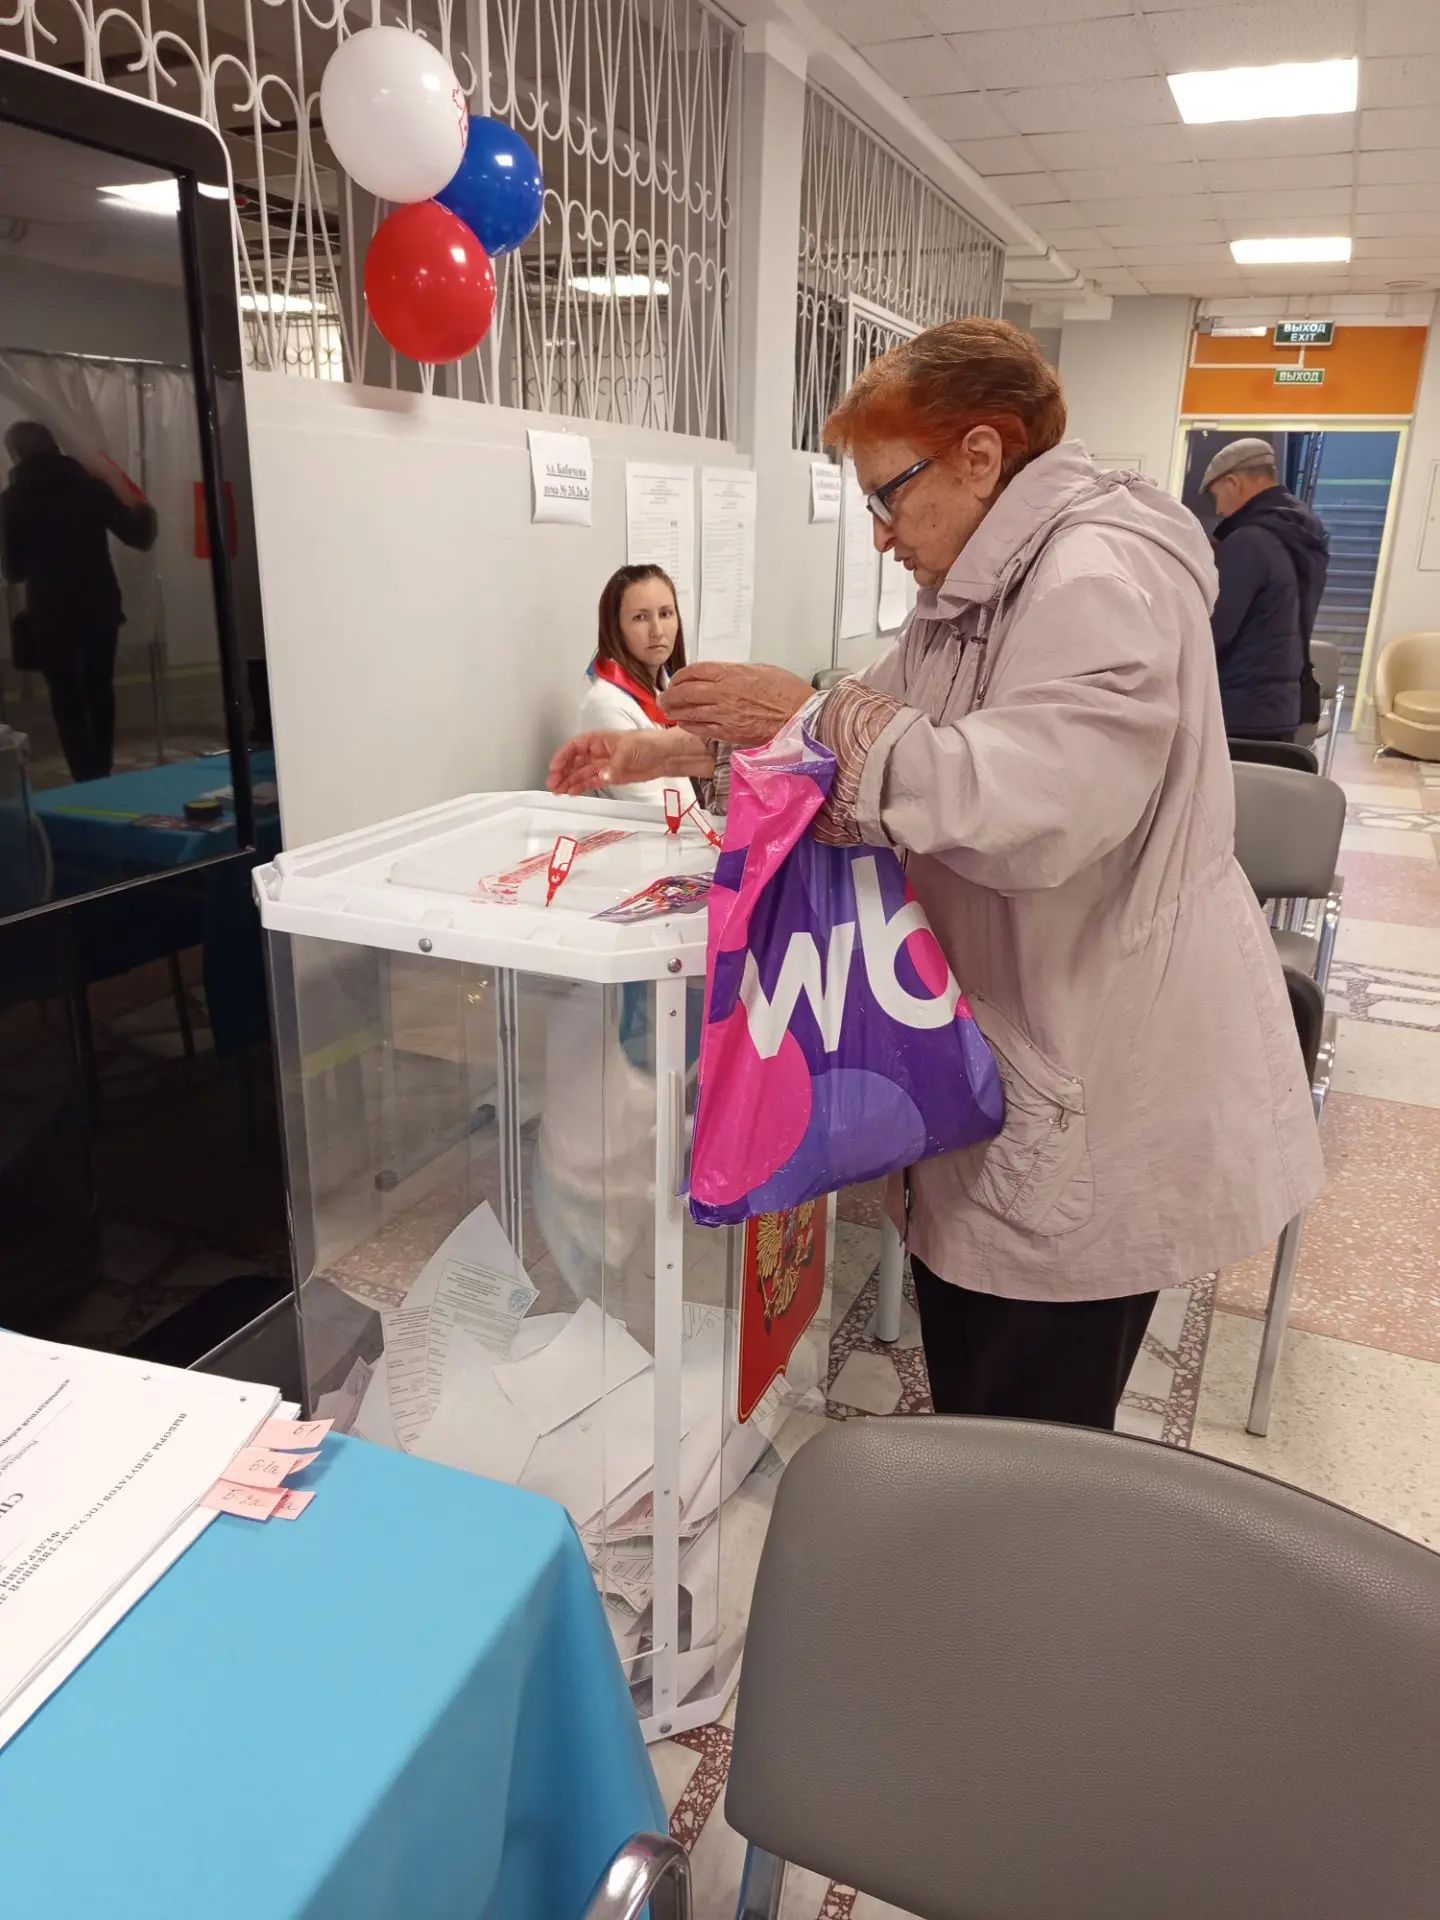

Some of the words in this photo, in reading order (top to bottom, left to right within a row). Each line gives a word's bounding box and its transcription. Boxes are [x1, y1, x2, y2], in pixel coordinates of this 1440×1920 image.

[1283, 323, 1326, 334] ВЫХОД
[1290, 333, 1316, 342] EXIT
[1278, 372, 1320, 382] ВЫХОД
[152, 1412, 188, 1451] ВЫБОРЫ
[103, 1451, 154, 1501] ДЕПУТАТОВ
[8, 1502, 104, 1592] ГОСУДАРСТВЕННОЙ
